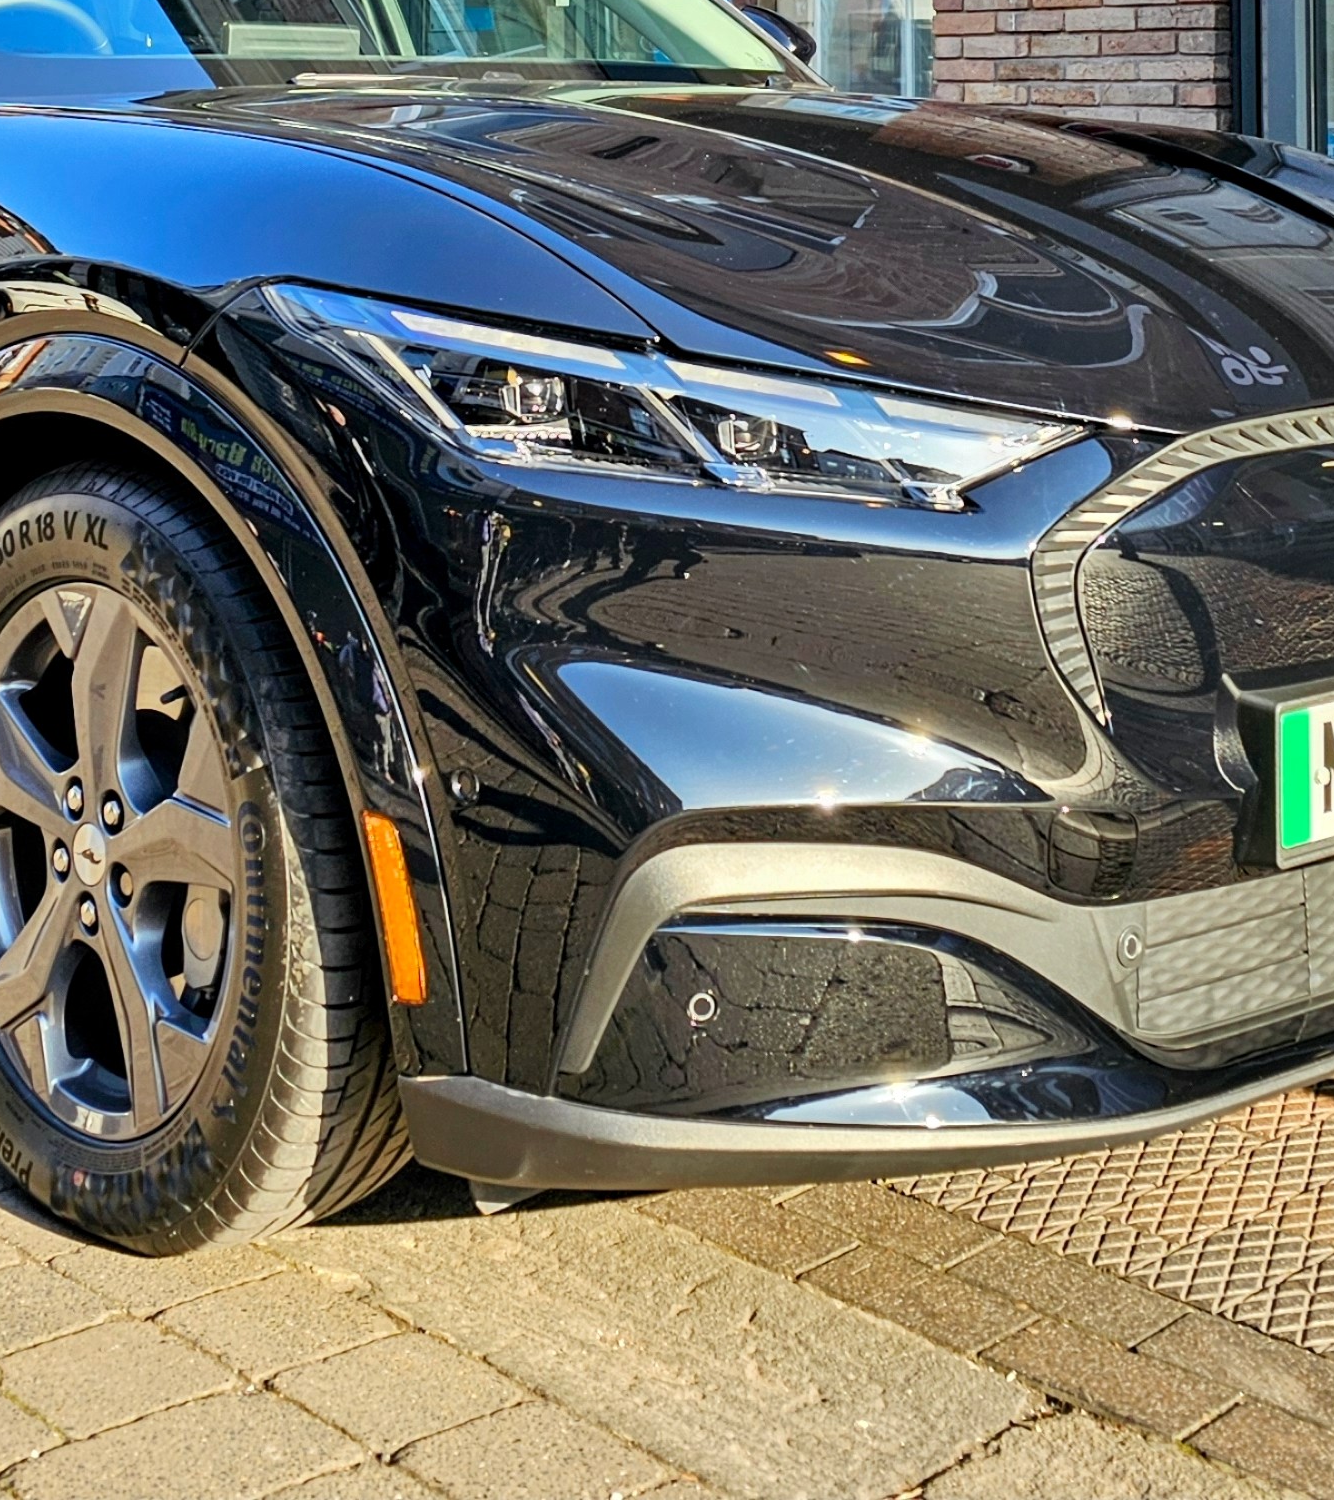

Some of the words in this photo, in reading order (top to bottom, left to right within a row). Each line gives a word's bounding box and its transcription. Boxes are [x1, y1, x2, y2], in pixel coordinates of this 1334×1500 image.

[64, 510, 78, 540] V
[83, 513, 109, 550] XL
[221, 800, 267, 1098] Continental
